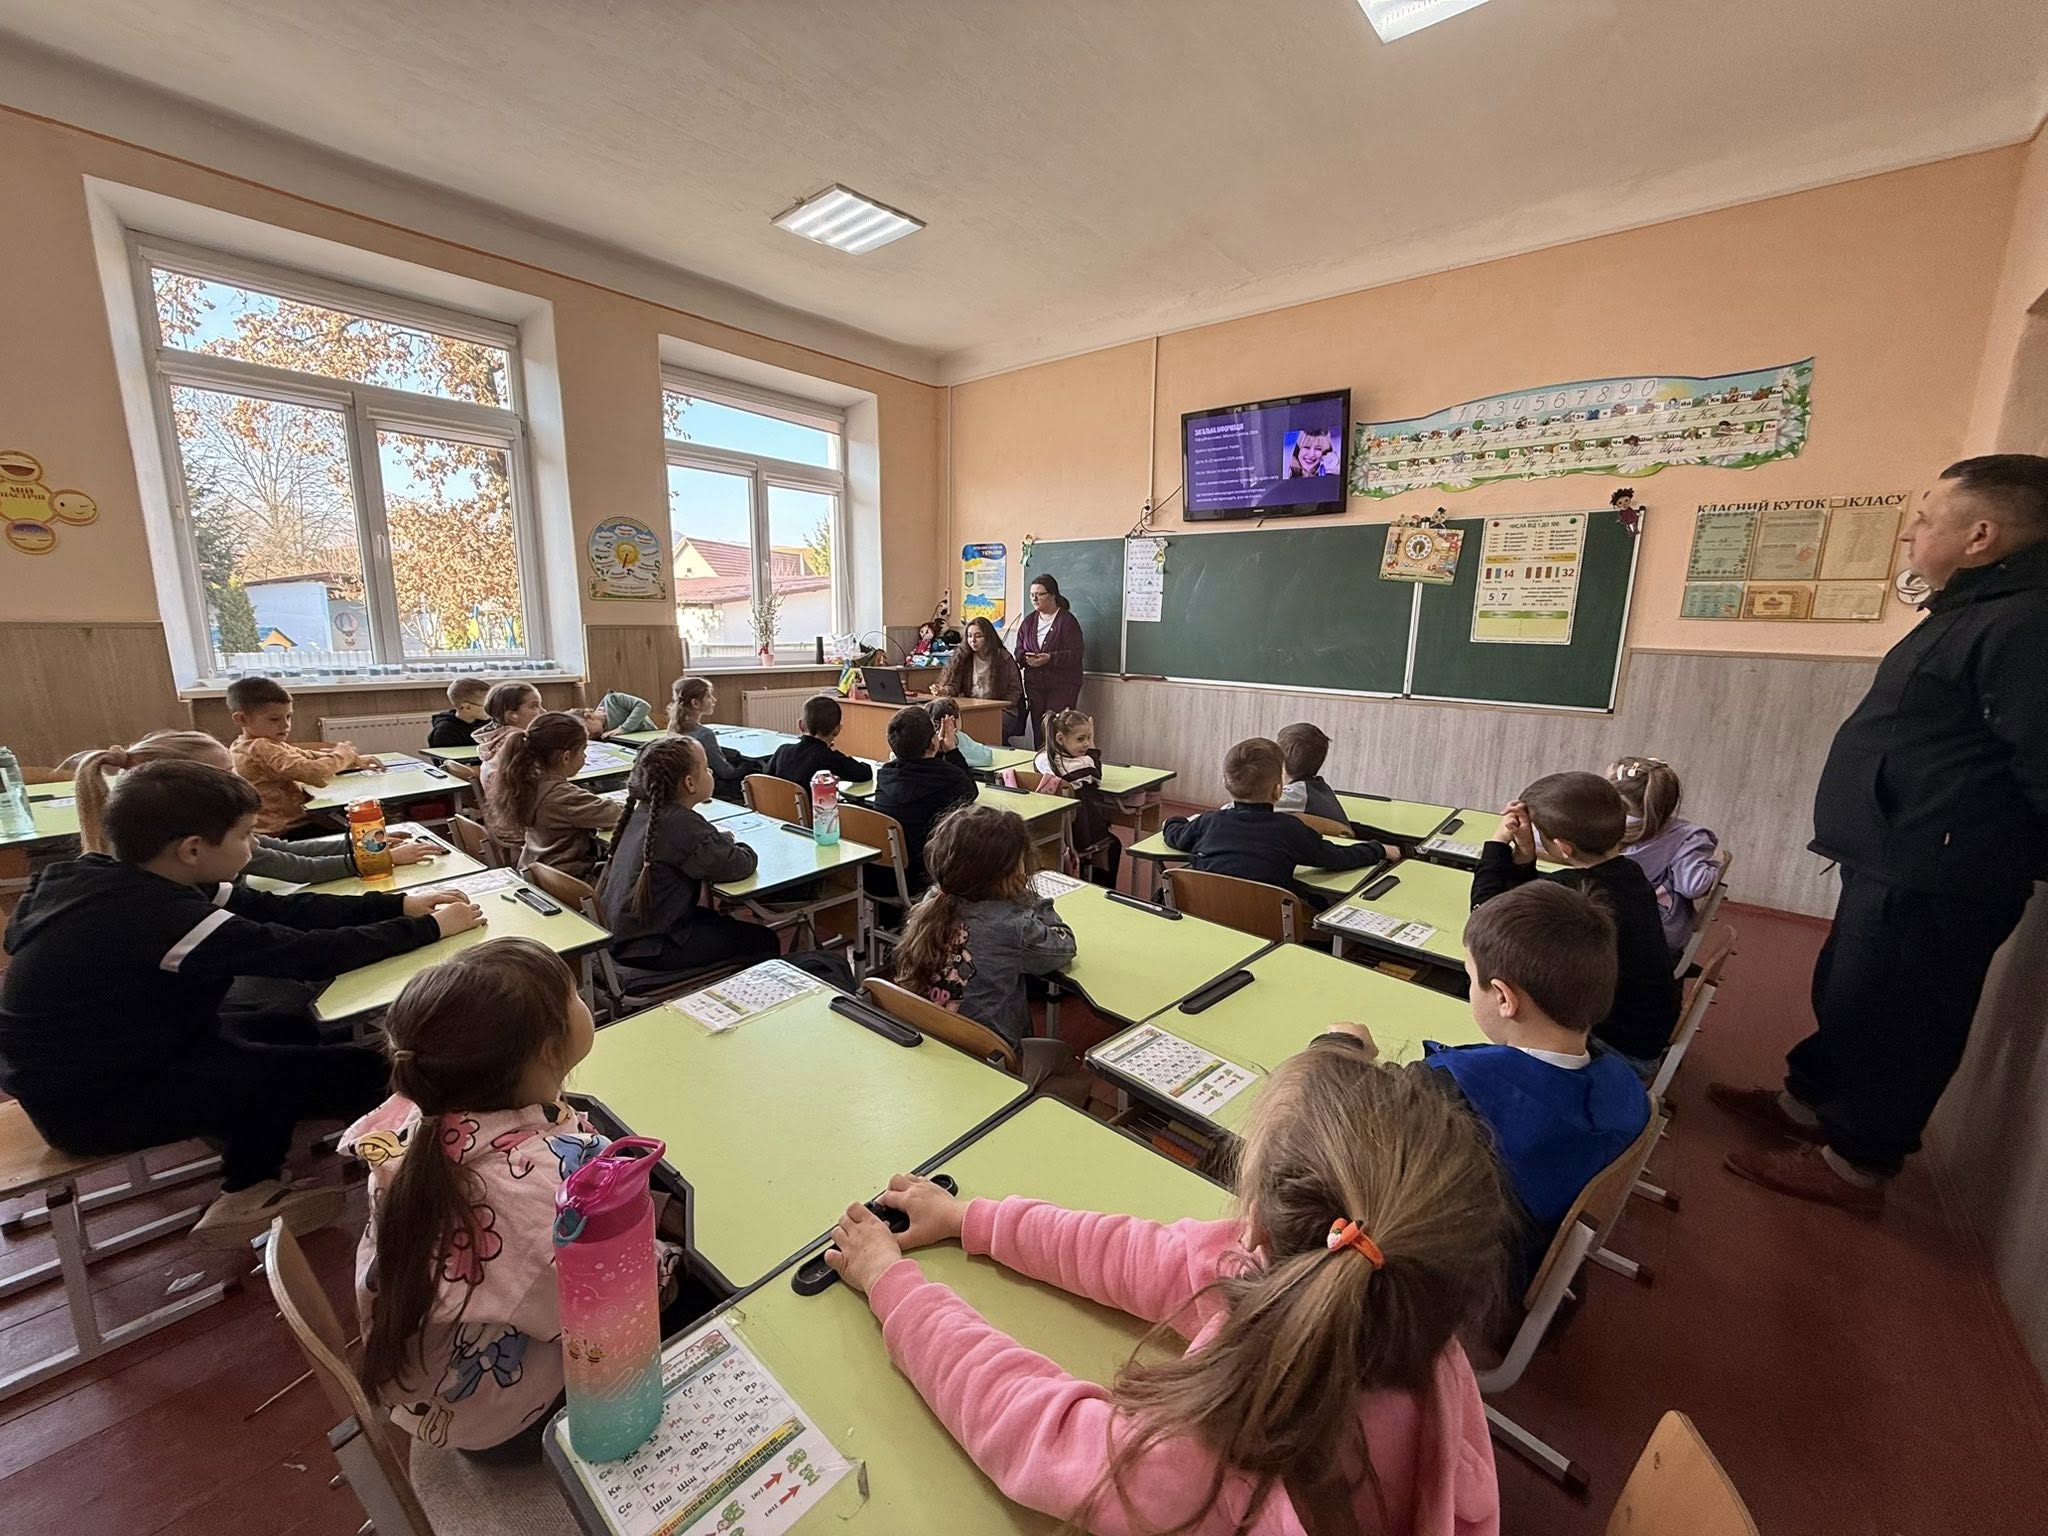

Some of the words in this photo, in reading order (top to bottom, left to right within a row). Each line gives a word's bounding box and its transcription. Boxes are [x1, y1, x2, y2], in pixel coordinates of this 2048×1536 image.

[1459, 406, 1467, 420] 1
[1475, 404, 1485, 418] 2
[1494, 401, 1505, 416] 3
[1513, 398, 1523, 414] 4
[1533, 395, 1545, 411] 5
[1554, 392, 1566, 408] 6
[1577, 389, 1588, 405] 7
[1597, 386, 1609, 402] 8
[1619, 383, 1632, 400] 9
[1641, 380, 1656, 397] 0
[1697, 499, 1769, 514] КЛАСНИЙ
[1773, 498, 1827, 511] КУТОК
[1849, 494, 1907, 507] КЛАСУ
[1504, 569, 1514, 578] 14
[1562, 568, 1575, 577] 32
[702, 1372, 716, 1384] Дд
[722, 1359, 734, 1368] Ее
[608, 1484, 622, 1496] Кк
[632, 1464, 648, 1478] Лл
[656, 1446, 672, 1460] Мм
[680, 1430, 694, 1441] Нн
[702, 1413, 716, 1424] Оо
[723, 1396, 736, 1408] Пп
[744, 1382, 758, 1393] Рр
[618, 1502, 632, 1514] Сс
[642, 1482, 656, 1494] Тт
[668, 1464, 680, 1474] Уу
[690, 1441, 708, 1456] Фф
[713, 1428, 726, 1439] Хх
[734, 1411, 749, 1424] Цц
[756, 1395, 768, 1405] Чч
[652, 1495, 672, 1512] Шш
[676, 1476, 698, 1492] Щщ
[724, 1438, 742, 1453] Юю
[747, 1424, 760, 1436] Яя
